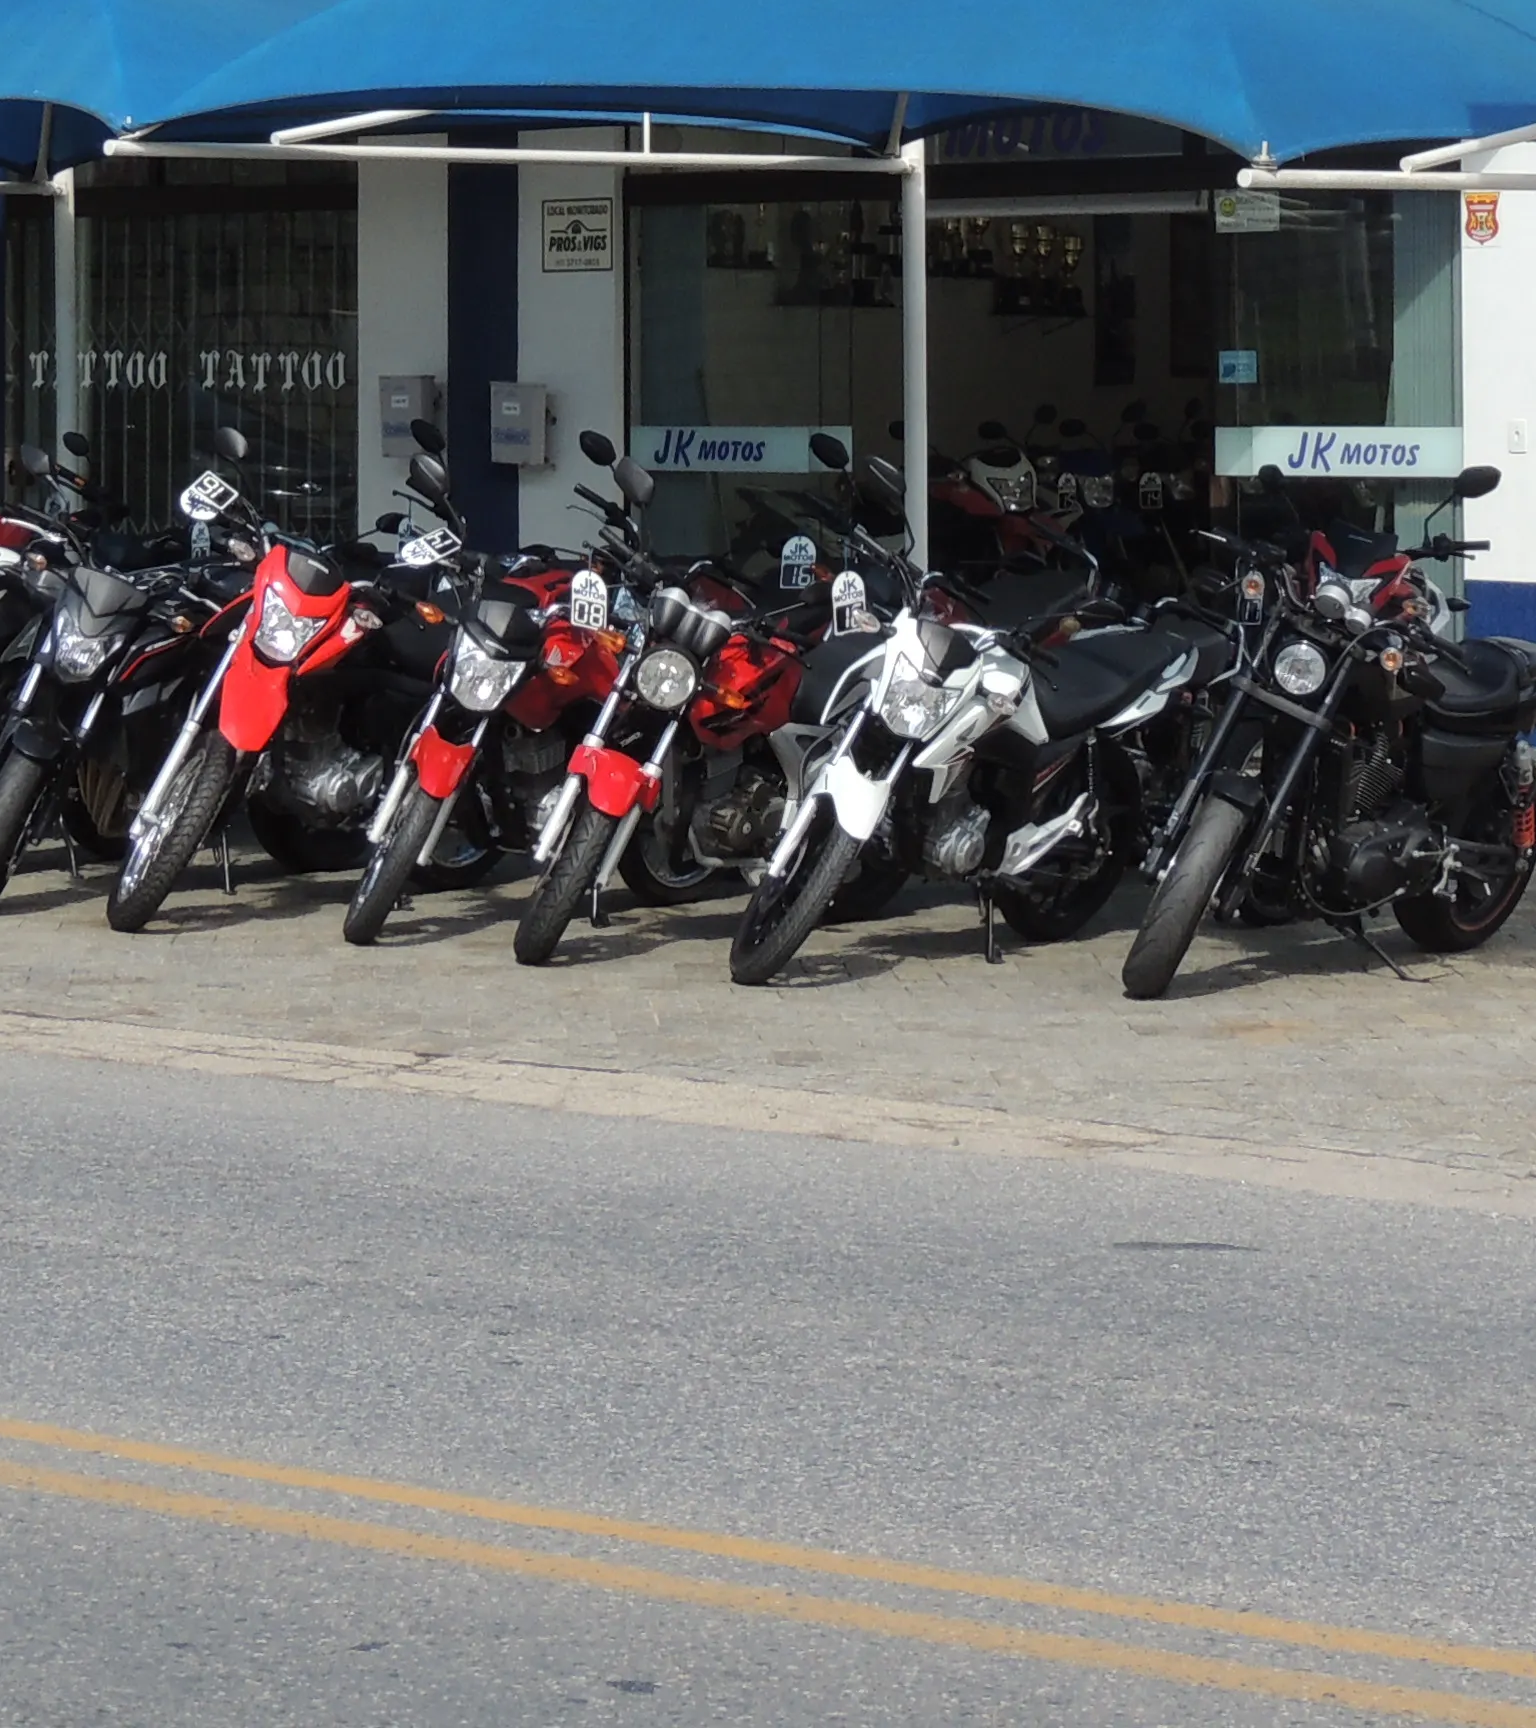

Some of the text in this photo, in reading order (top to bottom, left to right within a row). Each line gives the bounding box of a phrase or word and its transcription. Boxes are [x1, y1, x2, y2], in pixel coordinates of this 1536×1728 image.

[29, 349, 168, 390] TTTOO
[200, 349, 347, 392] TATTOO
[654, 428, 766, 468] JK MOTOS
[1287, 430, 1421, 472] JK MOTOS
[790, 542, 809, 555] JK
[579, 577, 600, 593] JK
[839, 578, 858, 594] JK
[574, 600, 604, 627] 08
